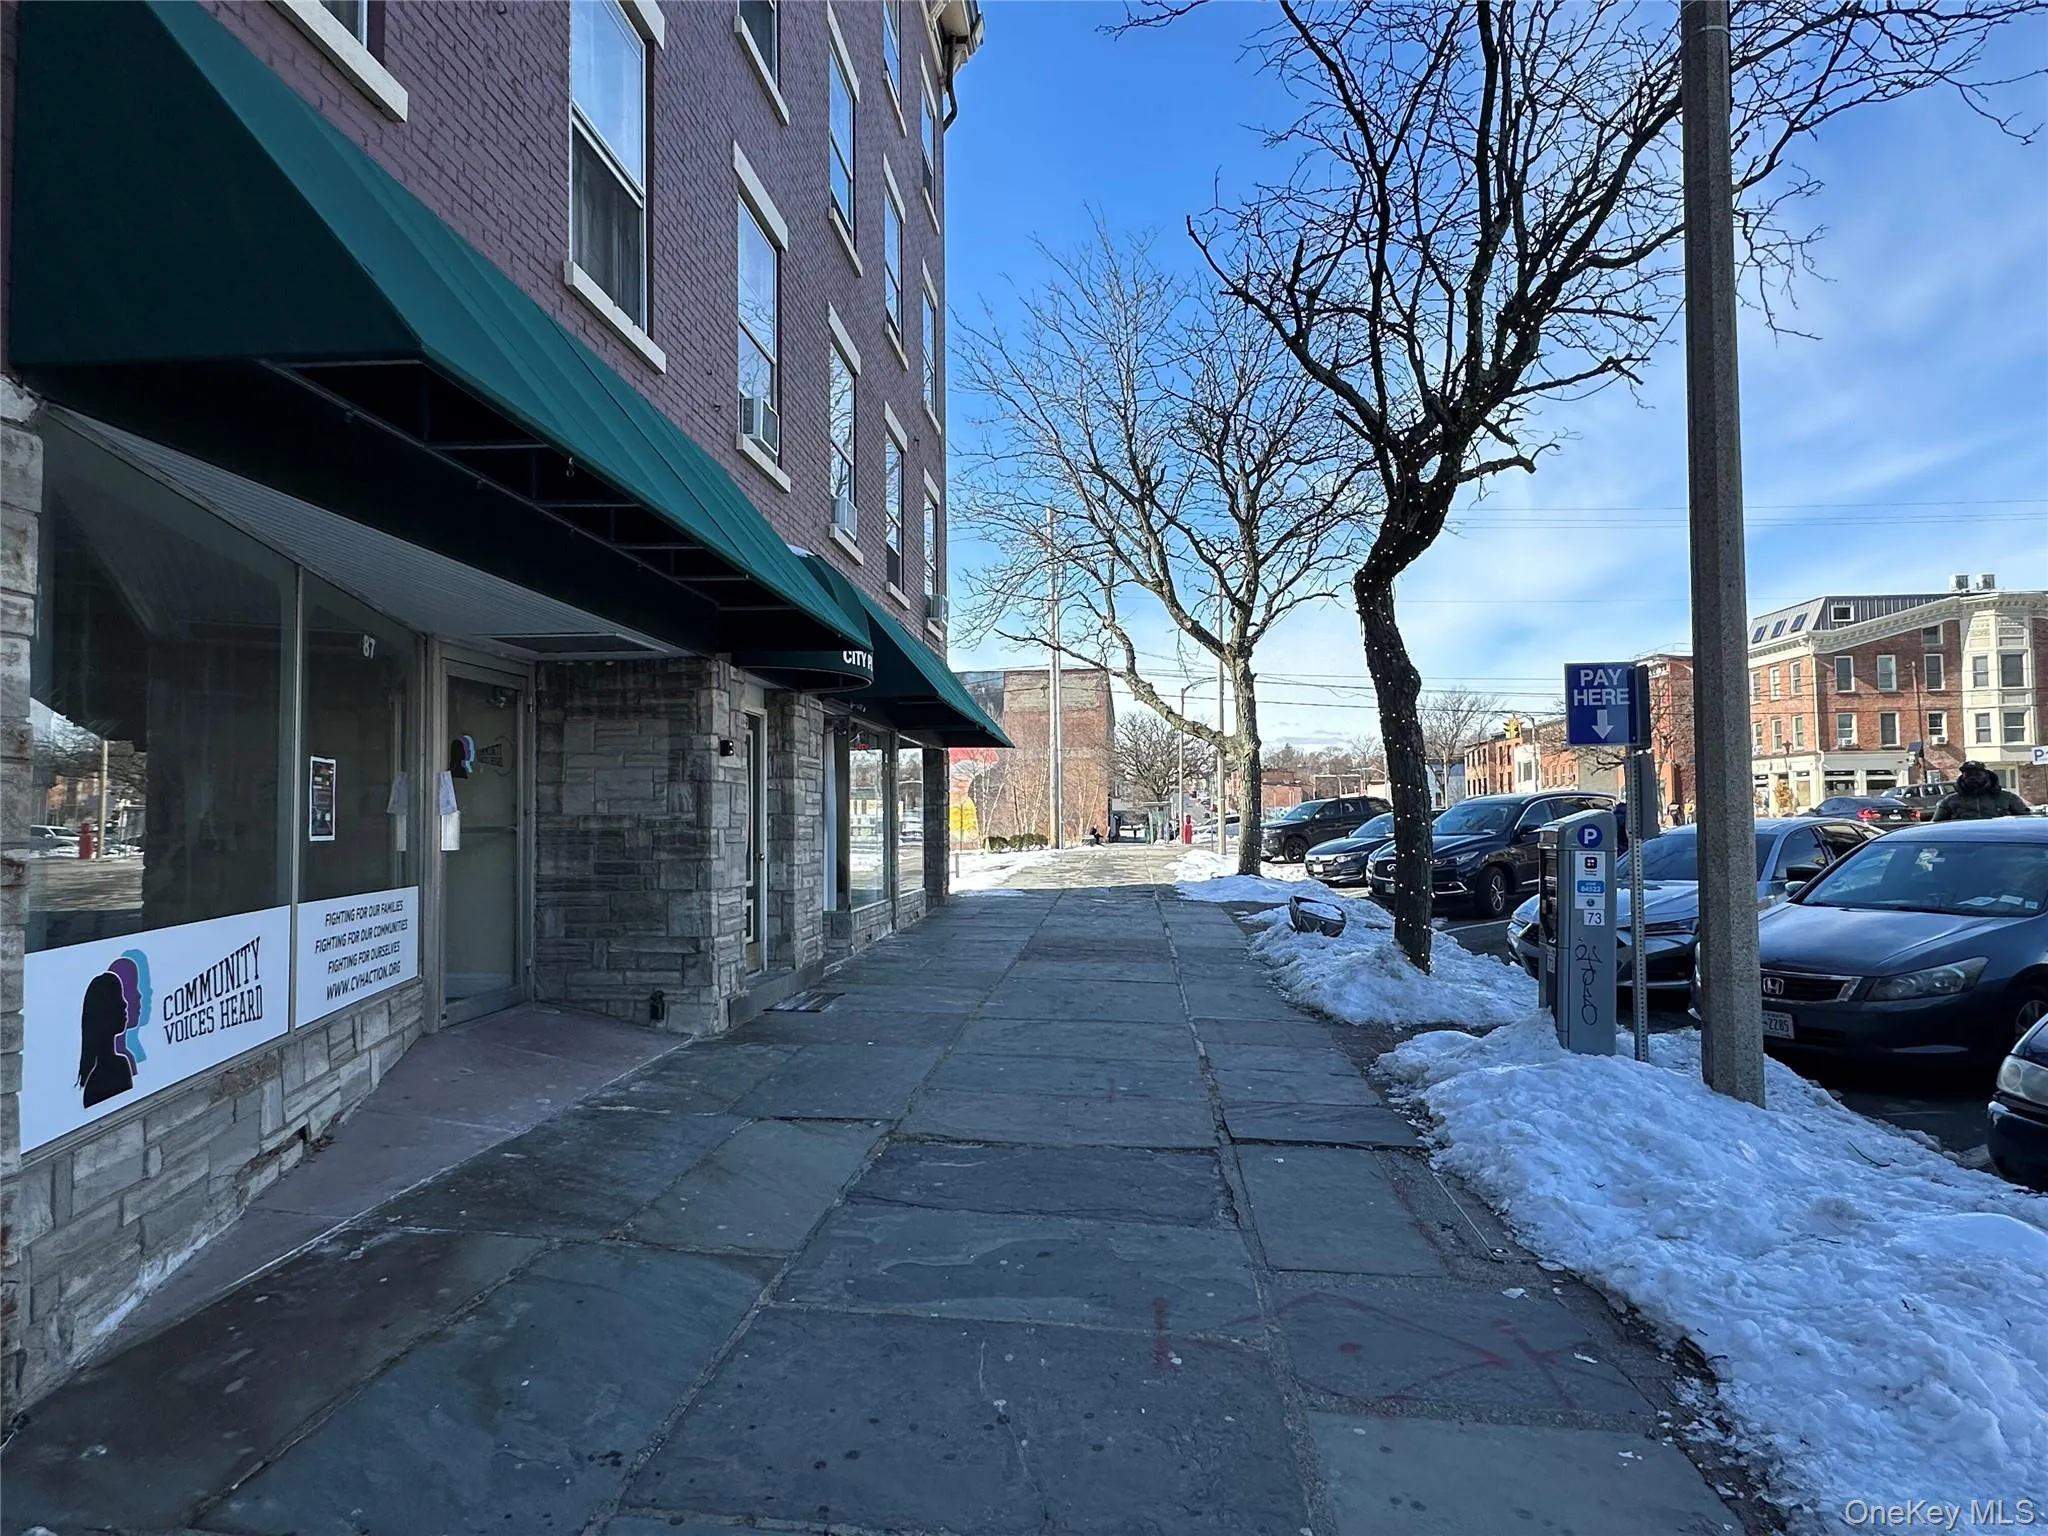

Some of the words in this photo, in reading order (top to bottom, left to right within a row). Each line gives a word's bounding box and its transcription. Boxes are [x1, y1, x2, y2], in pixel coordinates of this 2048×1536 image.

[363, 634, 375, 659] 87
[842, 651, 867, 668] CITY
[1580, 668, 1622, 686] PAY
[1574, 688, 1630, 706] HERE
[325, 908, 355, 927] FIGHTING
[356, 905, 368, 922] FOR
[369, 903, 381, 917] OUR
[381, 900, 404, 916] FAMILIES
[1587, 912, 1602, 925] 73
[314, 933, 347, 954] FIGHTING
[347, 930, 360, 945] FOR
[360, 927, 373, 941] OUR
[373, 919, 408, 938] COMMUNITIES
[328, 953, 358, 975] FIGHTING
[358, 950, 370, 965] FOR
[370, 941, 401, 961] OURSELVES
[163, 936, 260, 1021] COMMUNITY
[326, 961, 401, 1000] WWW.CVHACTION.ORG
[163, 1005, 215, 1044] VOICES
[220, 985, 263, 1030] HEARD
